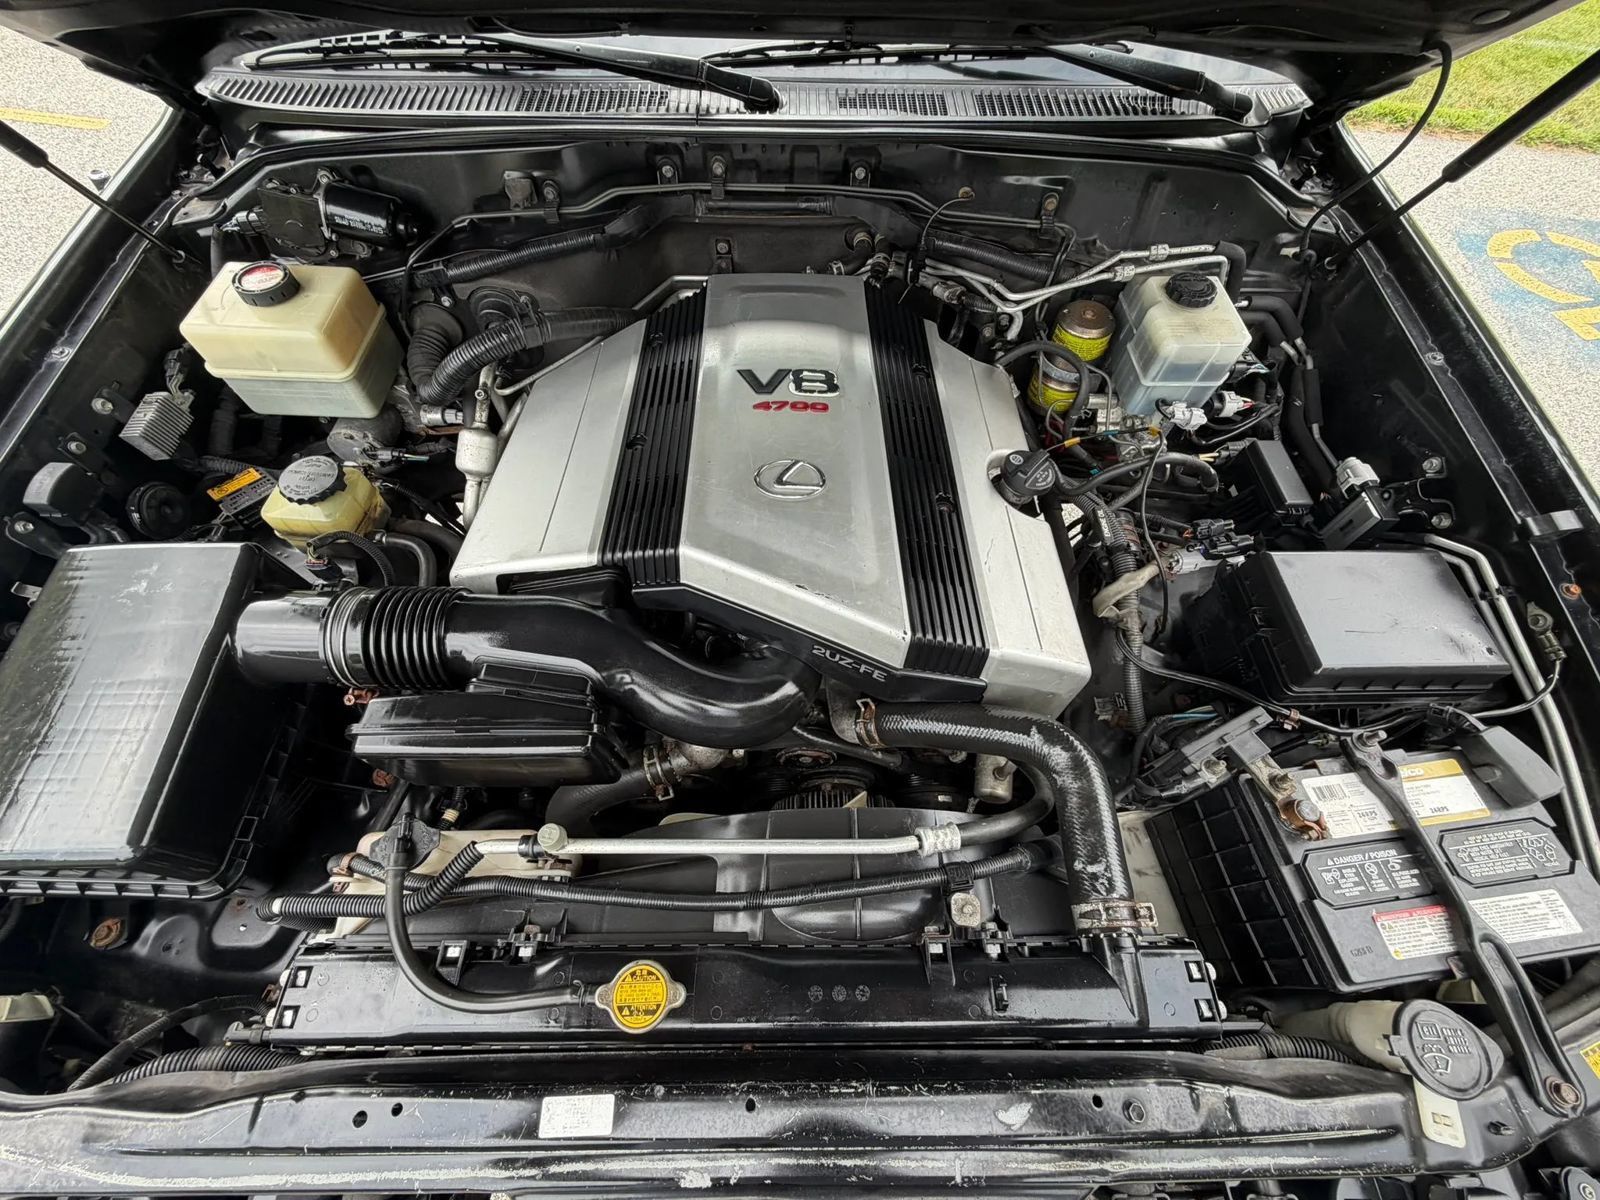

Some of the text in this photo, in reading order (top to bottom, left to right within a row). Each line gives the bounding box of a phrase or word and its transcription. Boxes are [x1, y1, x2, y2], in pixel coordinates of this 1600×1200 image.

[737, 369, 840, 397] V8
[752, 400, 830, 413] 4700
[812, 645, 888, 682] 2UZ-FE
[1333, 854, 1365, 865] DANGER
[1369, 849, 1398, 859] POISON
